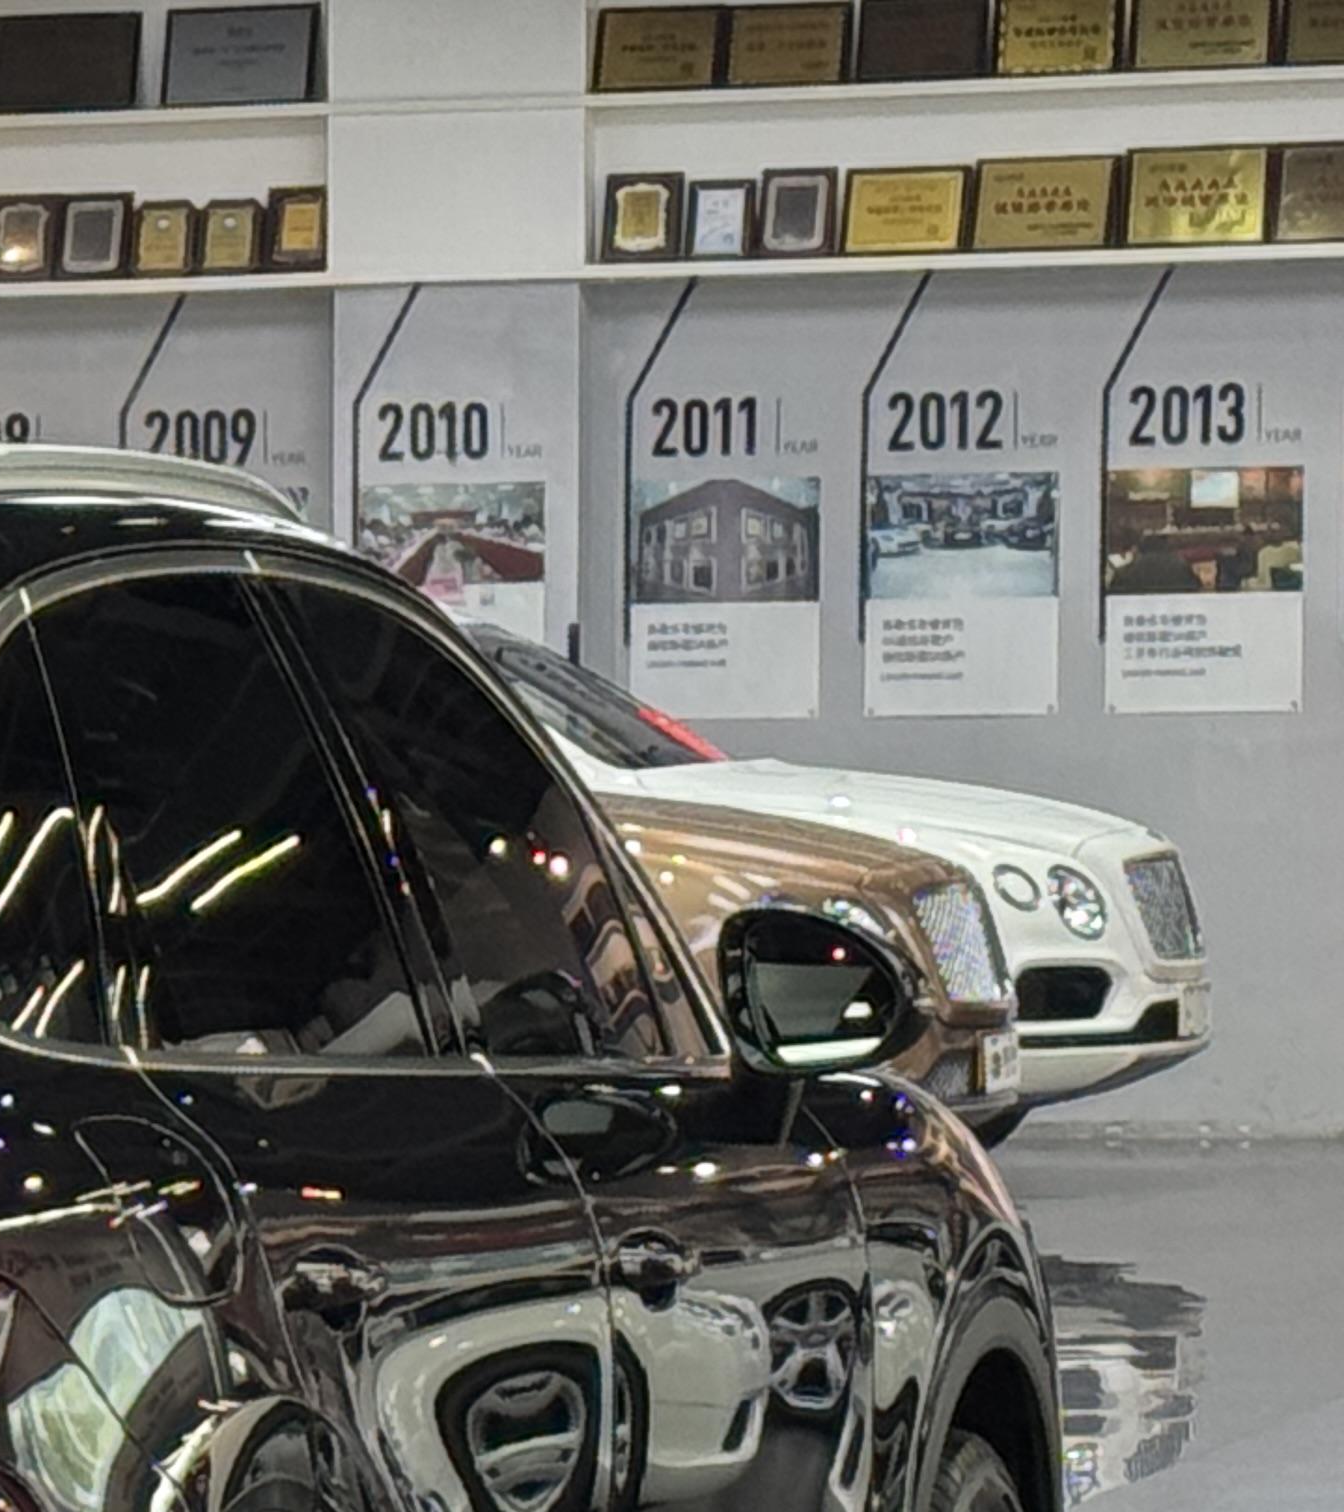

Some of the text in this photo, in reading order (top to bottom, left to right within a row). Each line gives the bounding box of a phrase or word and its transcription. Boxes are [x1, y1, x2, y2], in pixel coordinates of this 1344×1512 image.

[145, 408, 256, 466] 2009
[378, 401, 489, 463] 2010
[651, 396, 758, 458] 2011
[887, 389, 1004, 453] 2012
[1129, 382, 1303, 447] 2013 YEAR
